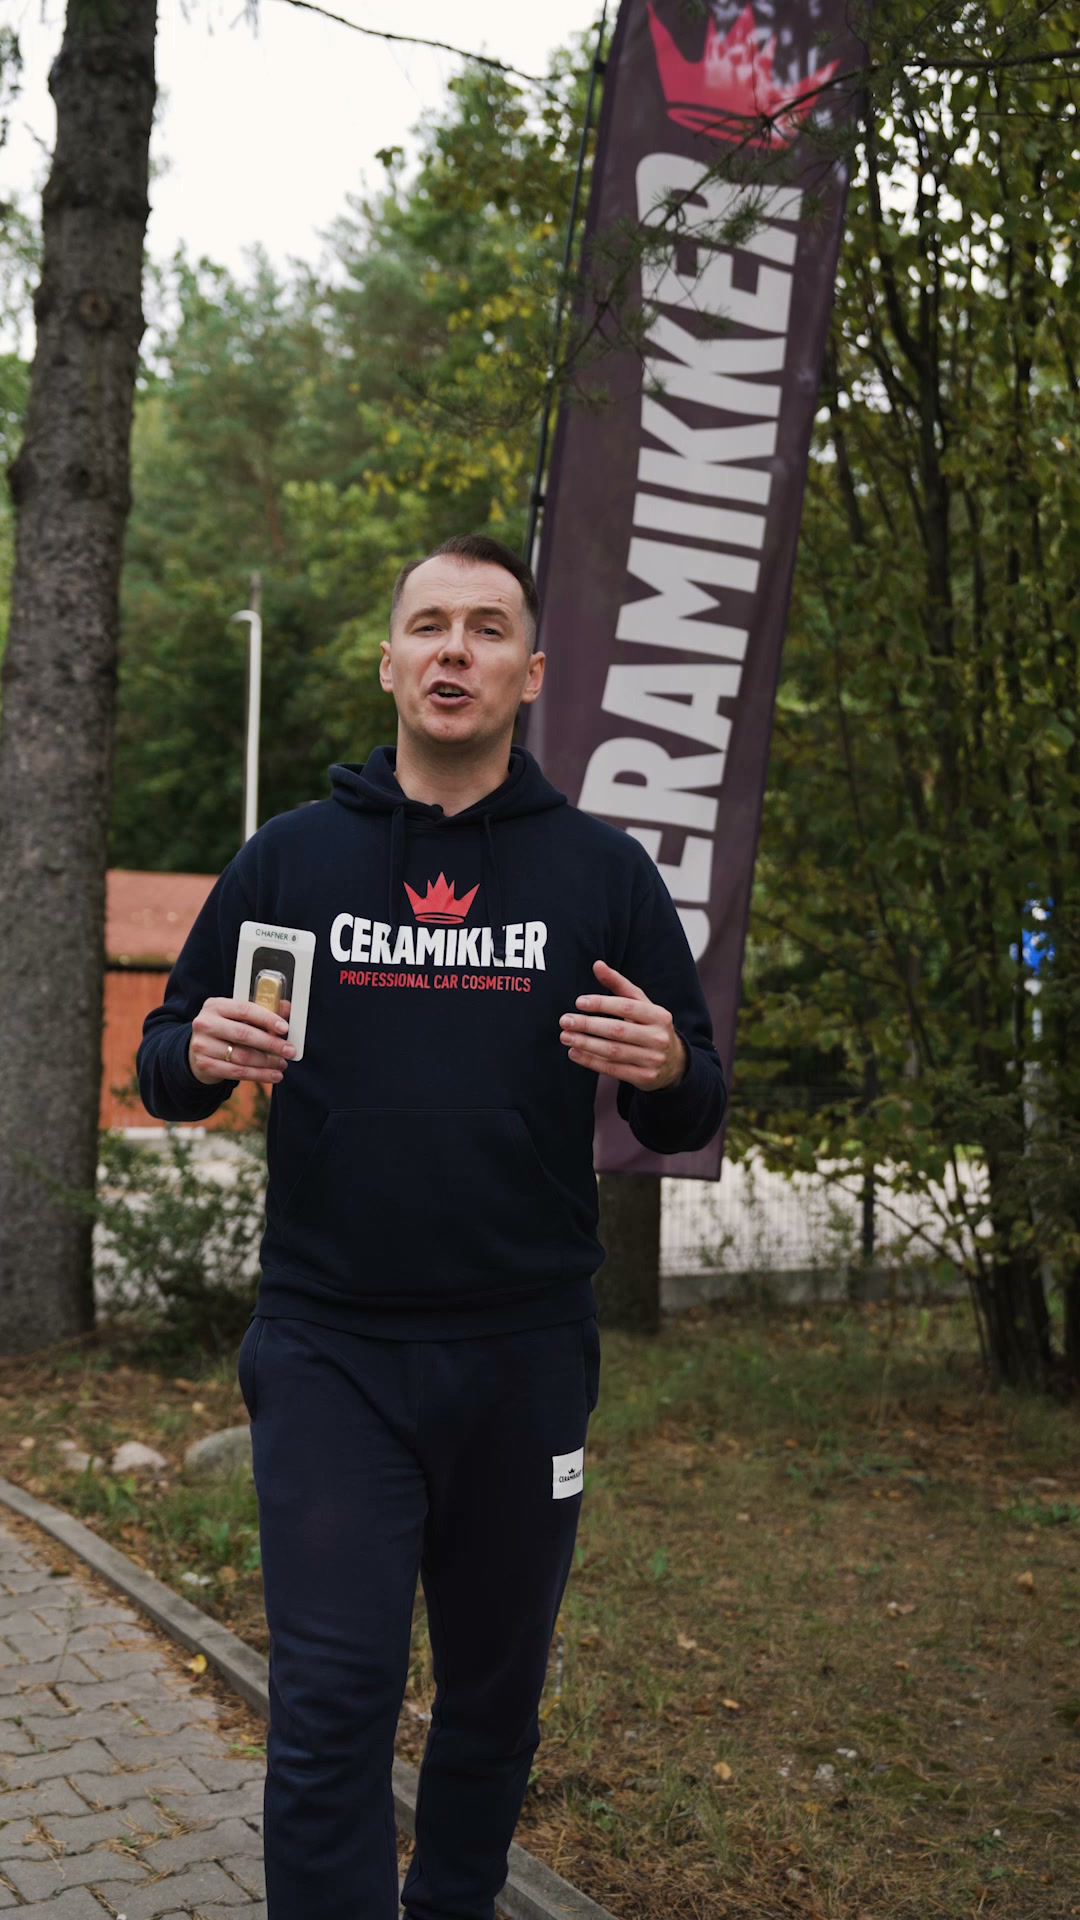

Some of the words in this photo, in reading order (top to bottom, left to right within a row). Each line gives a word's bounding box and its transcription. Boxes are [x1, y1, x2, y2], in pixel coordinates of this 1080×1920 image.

[577, 153, 803, 963] ERAMIKKER
[339, 969, 430, 990] PROFESSIONAL
[433, 974, 458, 990] CAR
[461, 975, 531, 993] COSMETICS
